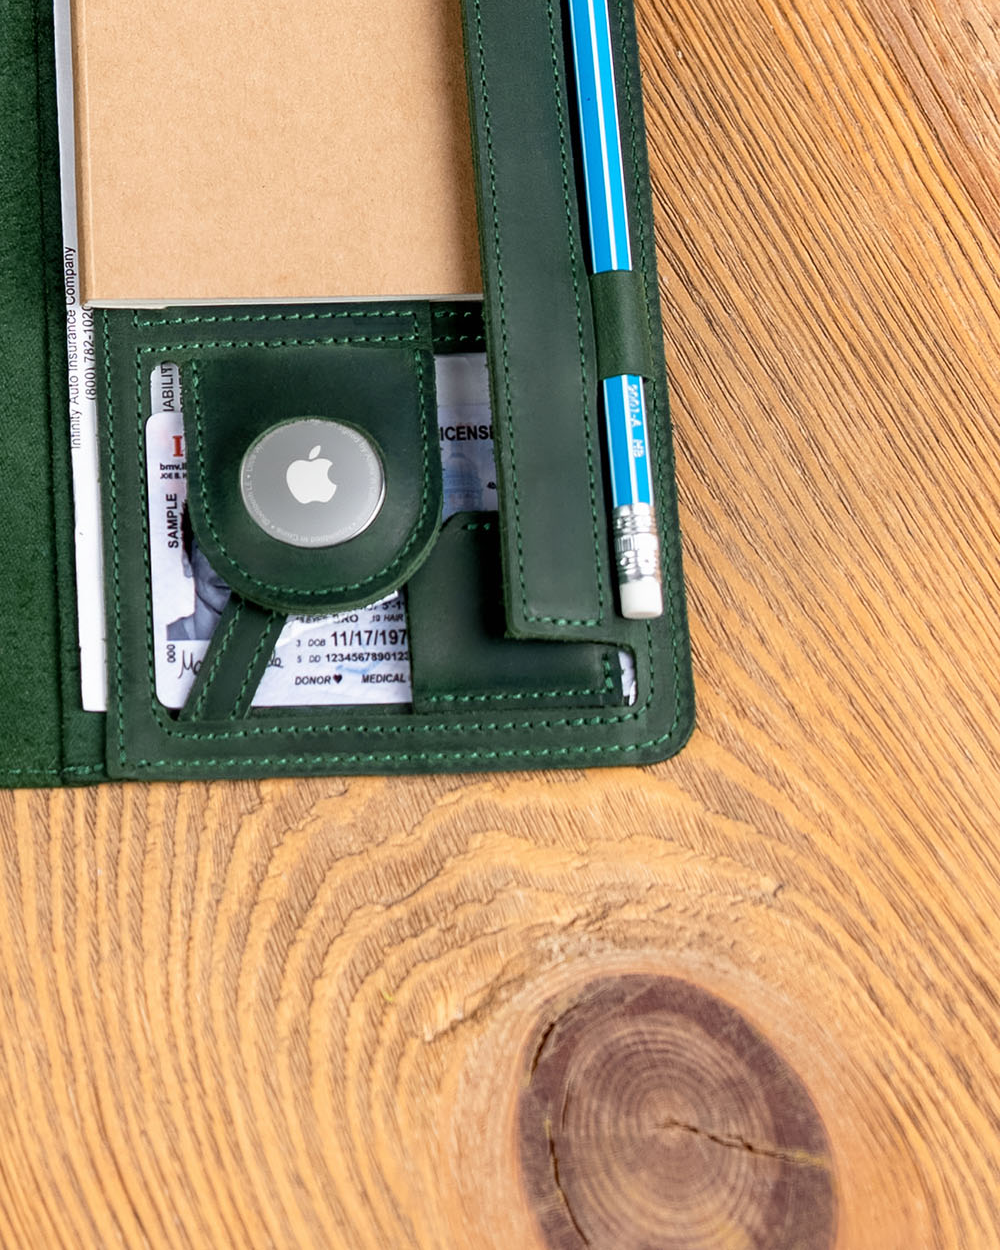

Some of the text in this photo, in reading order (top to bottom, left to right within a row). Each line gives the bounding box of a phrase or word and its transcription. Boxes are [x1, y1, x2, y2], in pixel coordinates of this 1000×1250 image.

[64, 246, 77, 305] Company
[67, 309, 78, 371] Insurance
[69, 375, 80, 405] Auto
[84, 368, 96, 400] (800)
[166, 493, 178, 549] SAMPLE
[295, 673, 406, 686] DONOR MEDICAL
